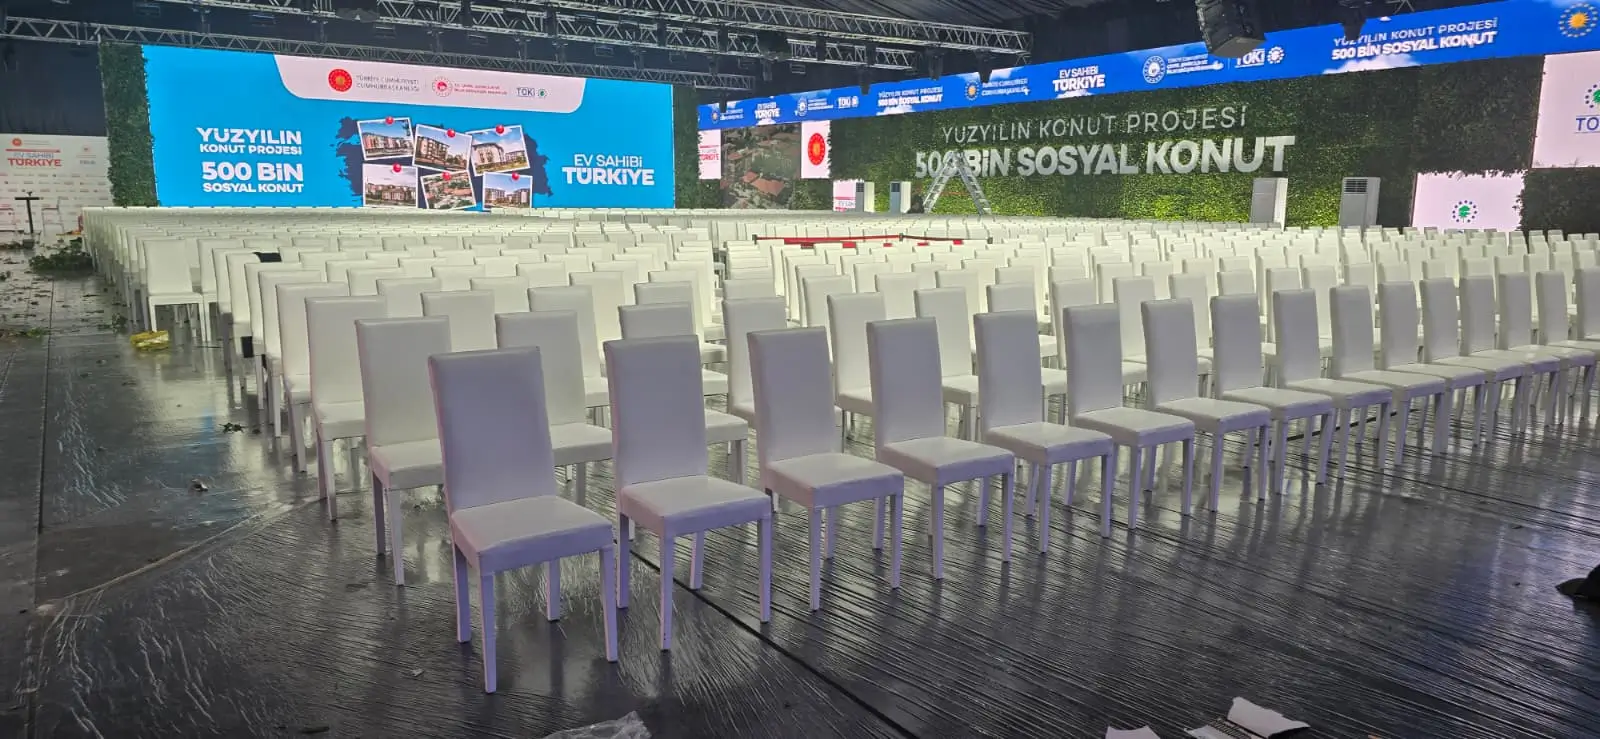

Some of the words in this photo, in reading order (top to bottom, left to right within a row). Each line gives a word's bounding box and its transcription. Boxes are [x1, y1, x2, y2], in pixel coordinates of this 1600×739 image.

[1391, 27, 1434, 40] KONUT
[1438, 17, 1498, 34] PROJESİ
[1331, 46, 1356, 60] 500
[1357, 43, 1381, 57] BİN
[1382, 38, 1438, 55] SOSYAL
[1440, 30, 1498, 48] KONUT
[1052, 74, 1105, 92] TÜRKİYE
[1059, 69, 1070, 79] EV
[1039, 115, 1117, 139] KONUT
[1127, 105, 1248, 134] PROJESİ
[196, 126, 302, 145] YÜZYILIN
[200, 143, 246, 154] KONUT
[248, 144, 302, 156] PROJESİ
[964, 148, 1010, 177] BİN
[1017, 144, 1139, 177] SOSYAL
[1146, 135, 1296, 175] KONUT
[574, 154, 593, 167] EV
[595, 154, 643, 168] SAHİBİ
[202, 161, 252, 181] 500
[256, 162, 304, 182] BİN
[562, 167, 655, 186] TÜRKİYE
[203, 182, 257, 193] SOSYAL
[258, 183, 304, 193] KONUT
